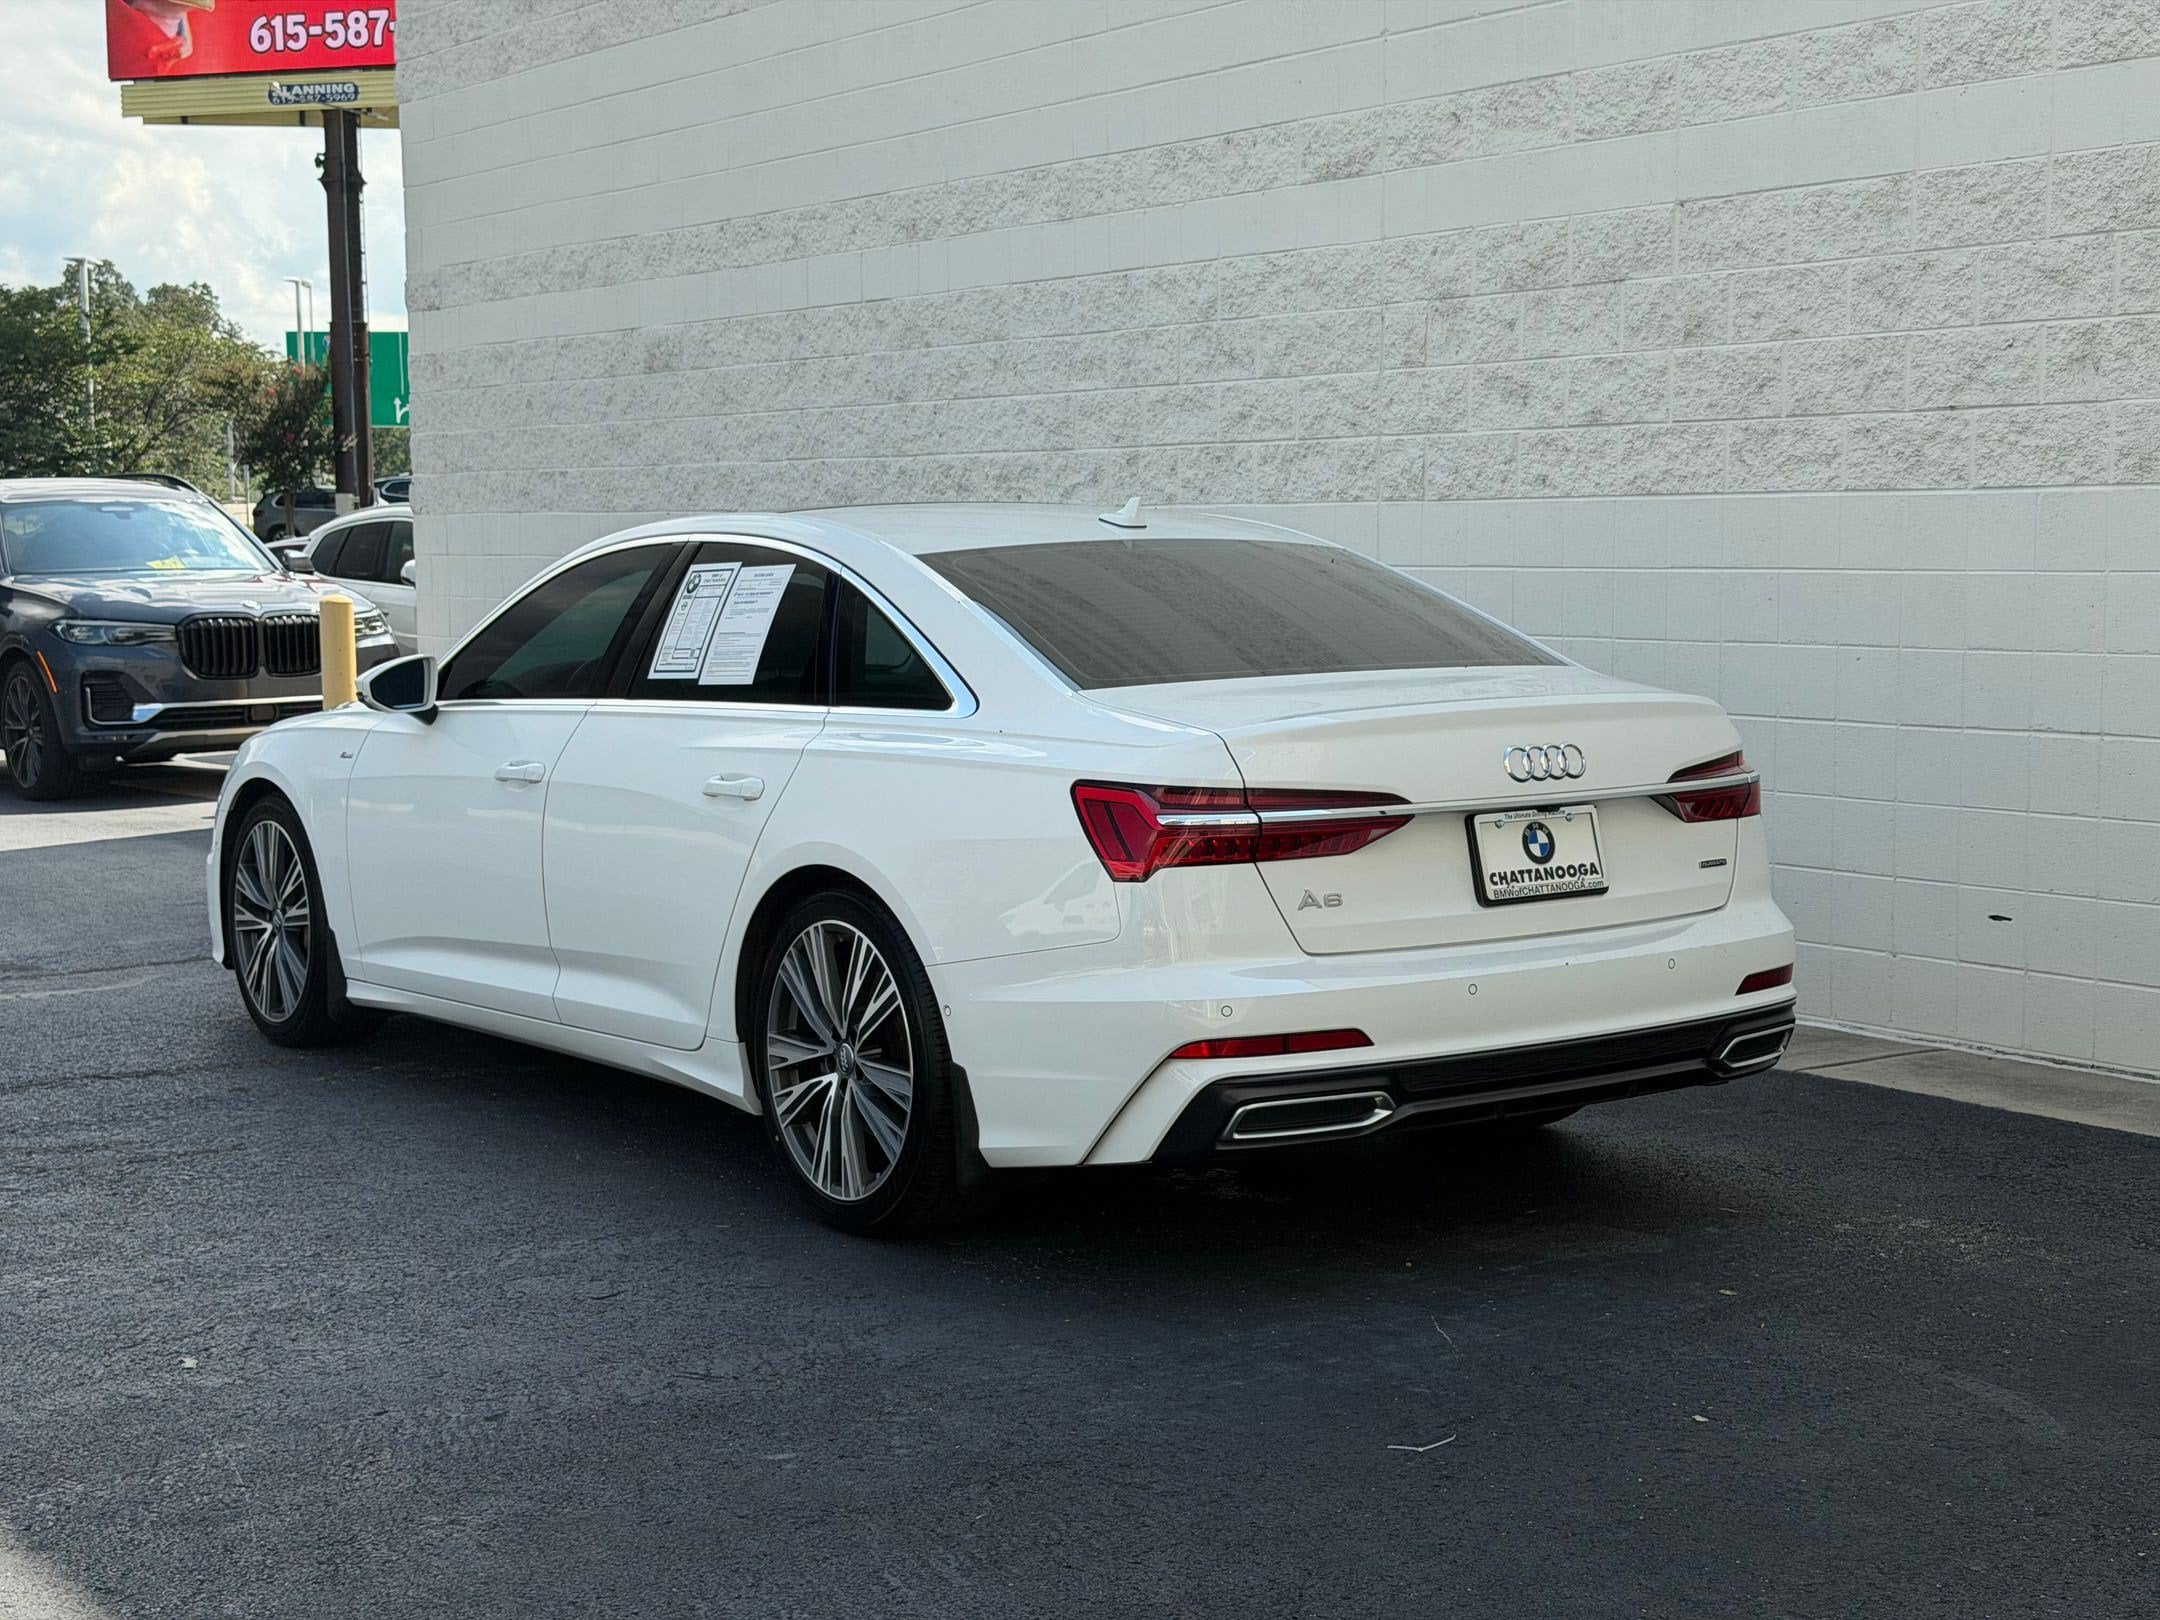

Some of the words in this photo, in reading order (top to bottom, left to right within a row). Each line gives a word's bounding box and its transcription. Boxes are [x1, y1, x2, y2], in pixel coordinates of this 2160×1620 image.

[1524, 823, 1549, 836] BMW
[1489, 862, 1600, 887] CHATTANOOGA
[1297, 889, 1343, 911] A6
